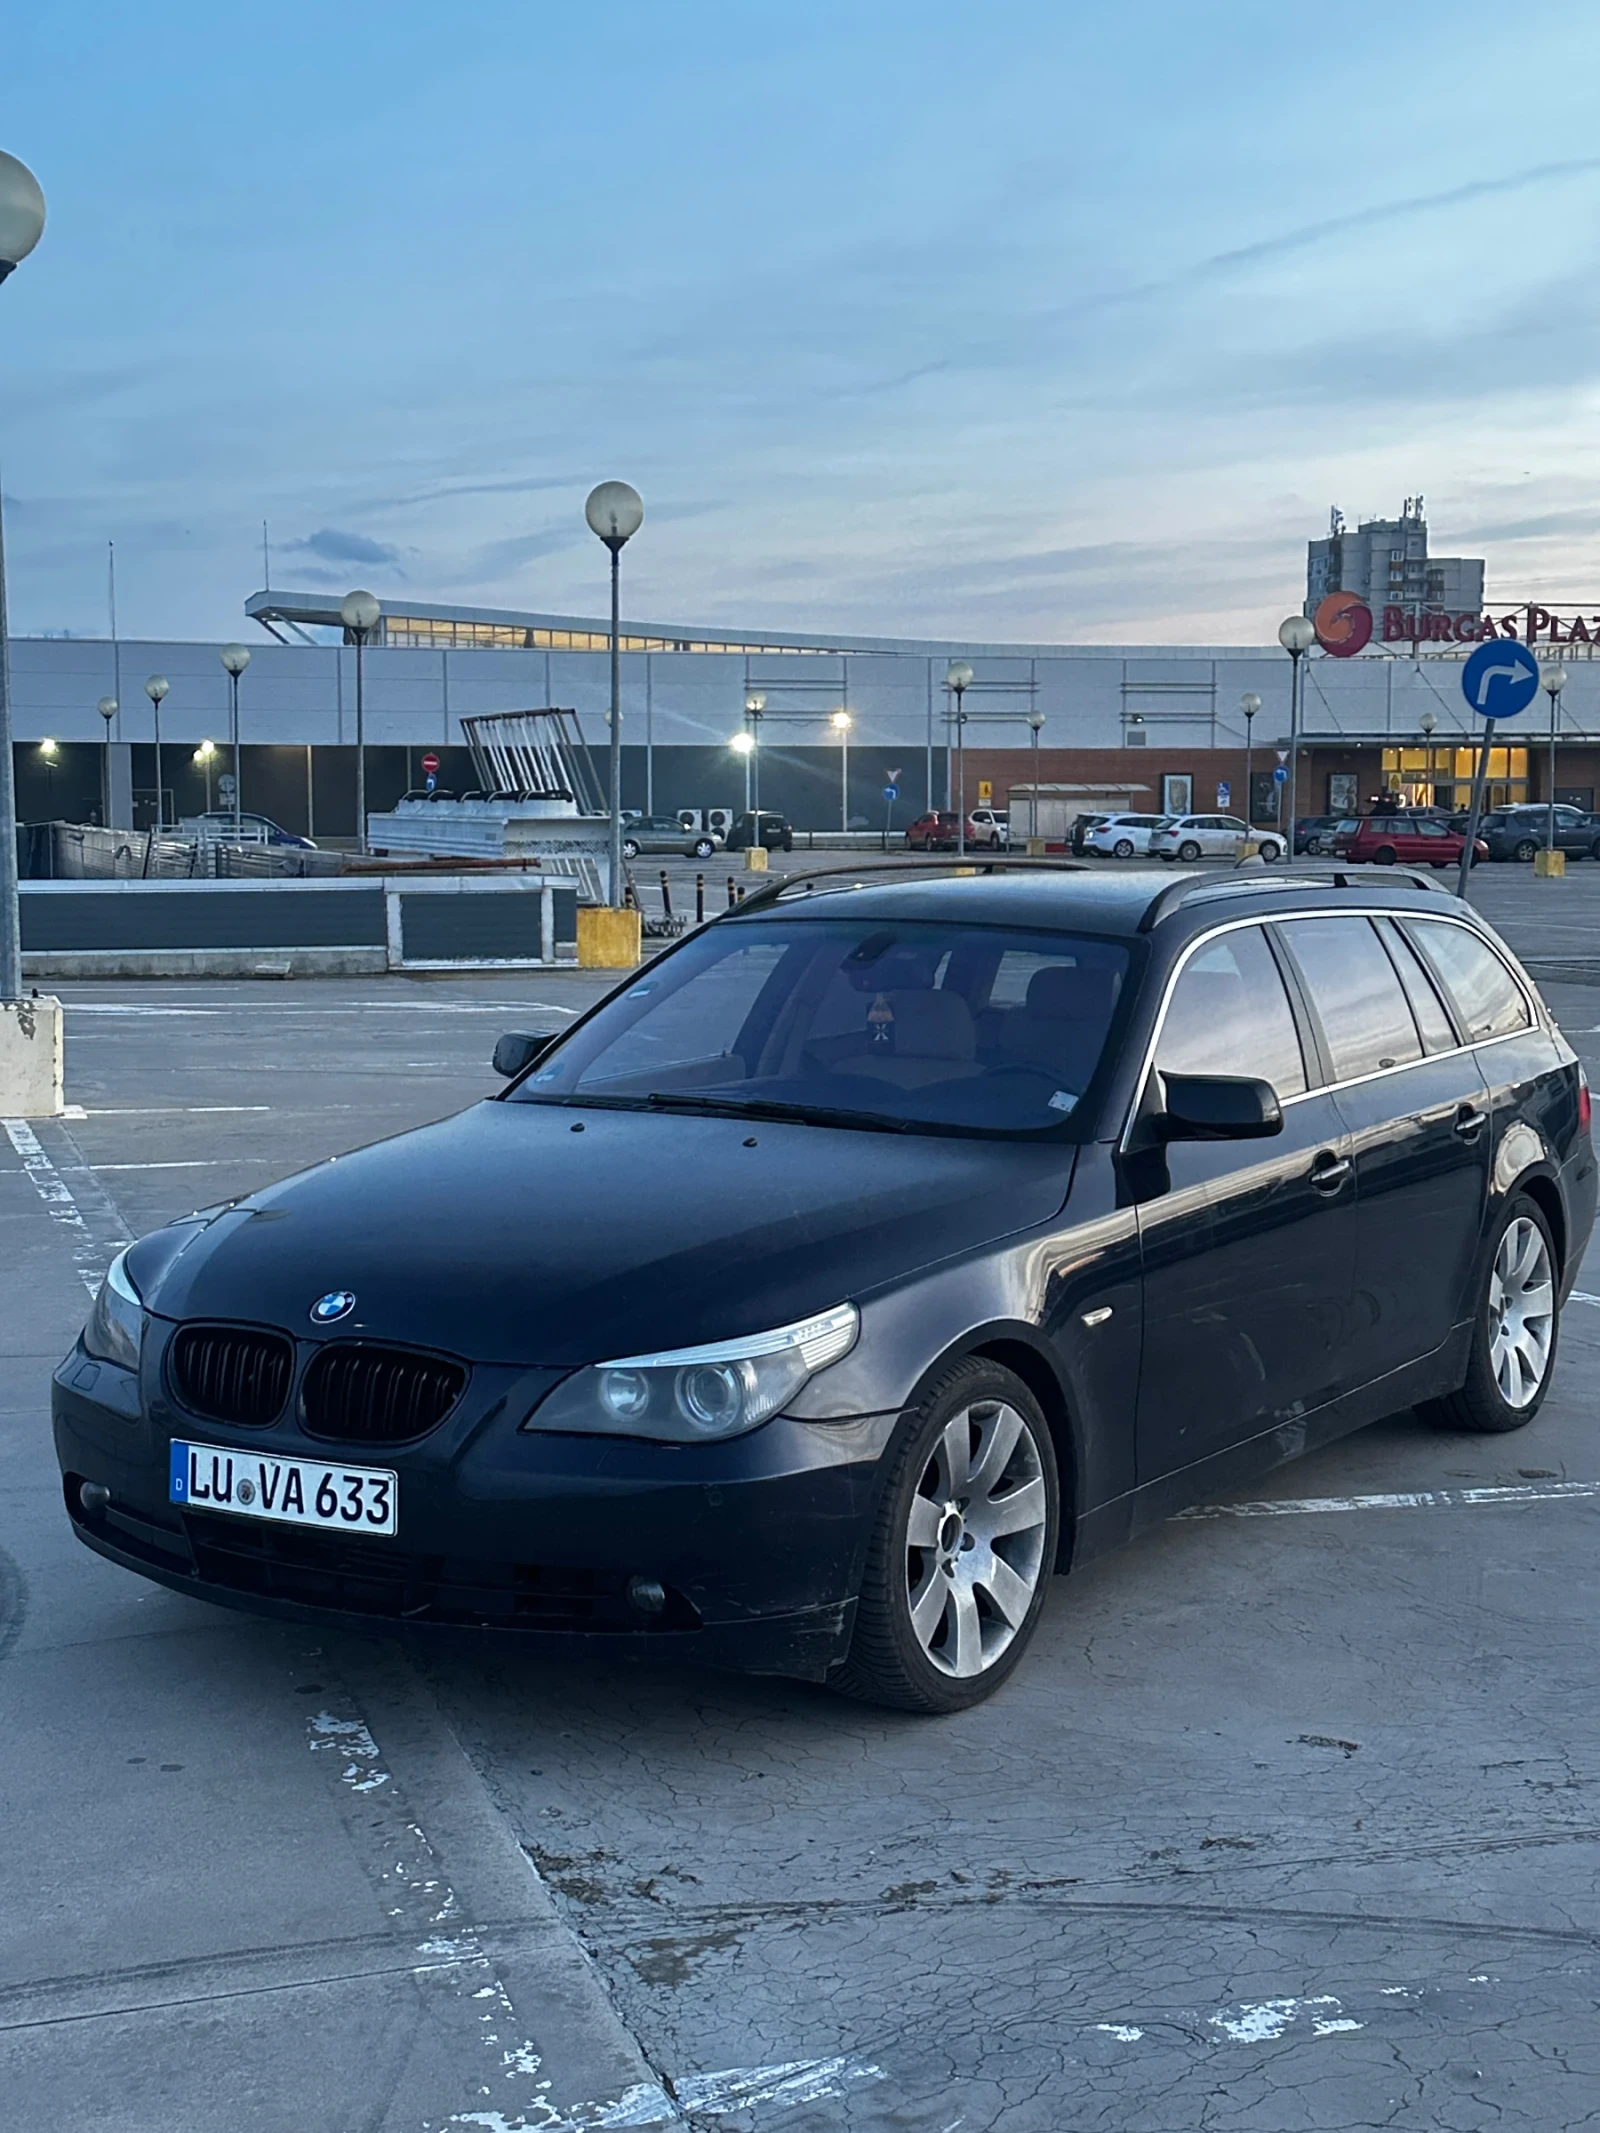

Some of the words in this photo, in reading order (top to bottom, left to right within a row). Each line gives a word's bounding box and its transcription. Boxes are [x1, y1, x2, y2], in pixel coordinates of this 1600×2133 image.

[1383, 605, 1518, 642] BURGAS
[175, 1477, 183, 1491] D
[190, 1452, 233, 1503] LU
[259, 1462, 304, 1514] VA
[316, 1472, 390, 1525] 633
